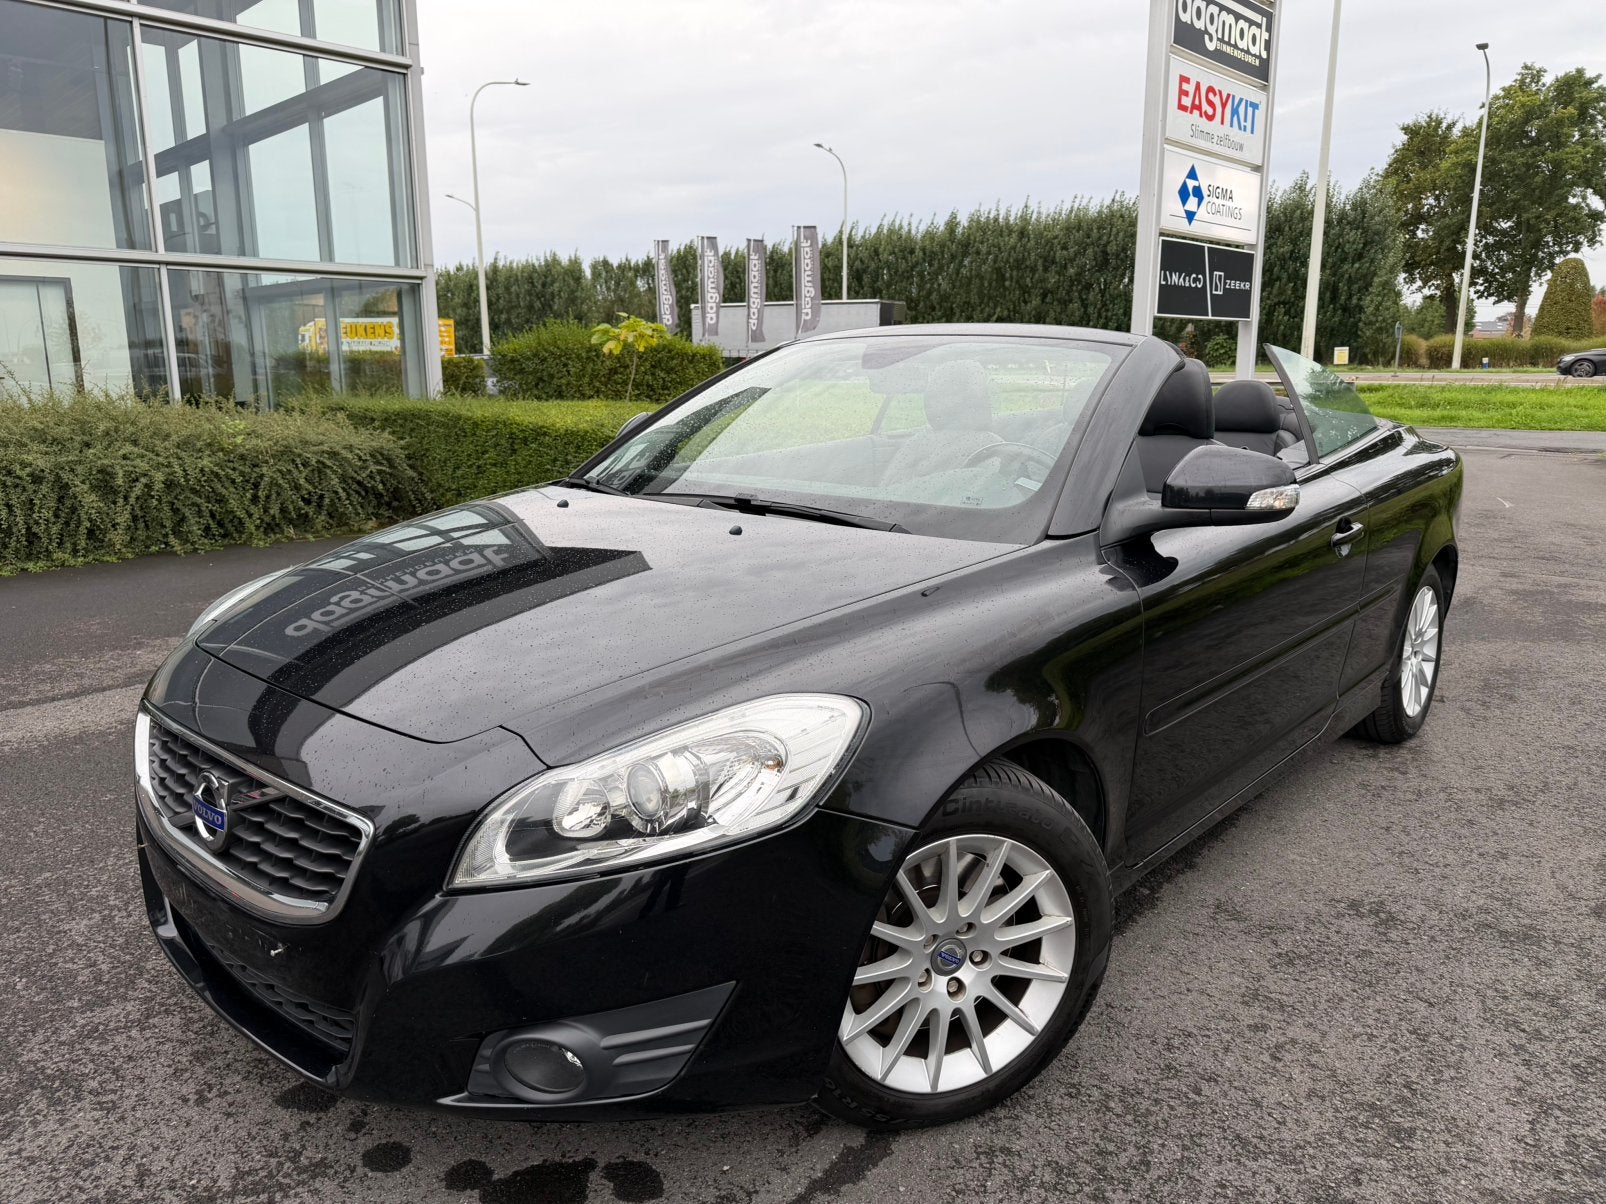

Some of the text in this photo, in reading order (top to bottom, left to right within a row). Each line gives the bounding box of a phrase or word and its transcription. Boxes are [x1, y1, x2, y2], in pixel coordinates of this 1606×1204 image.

[1177, 0, 1269, 59] dagmaat
[1216, 41, 1260, 67] BINNENDEUREN
[1190, 123, 1245, 152] Slimme zelfbouw
[1206, 184, 1234, 203] SIGMA
[1205, 200, 1243, 221] COATINGS
[704, 248, 720, 325] dagmaat
[748, 252, 760, 330] dagmaat
[800, 239, 815, 320] dagmaat
[1225, 279, 1251, 290] ZEEKR
[341, 321, 396, 341] EUKENS
[194, 801, 222, 825] VOLVO
